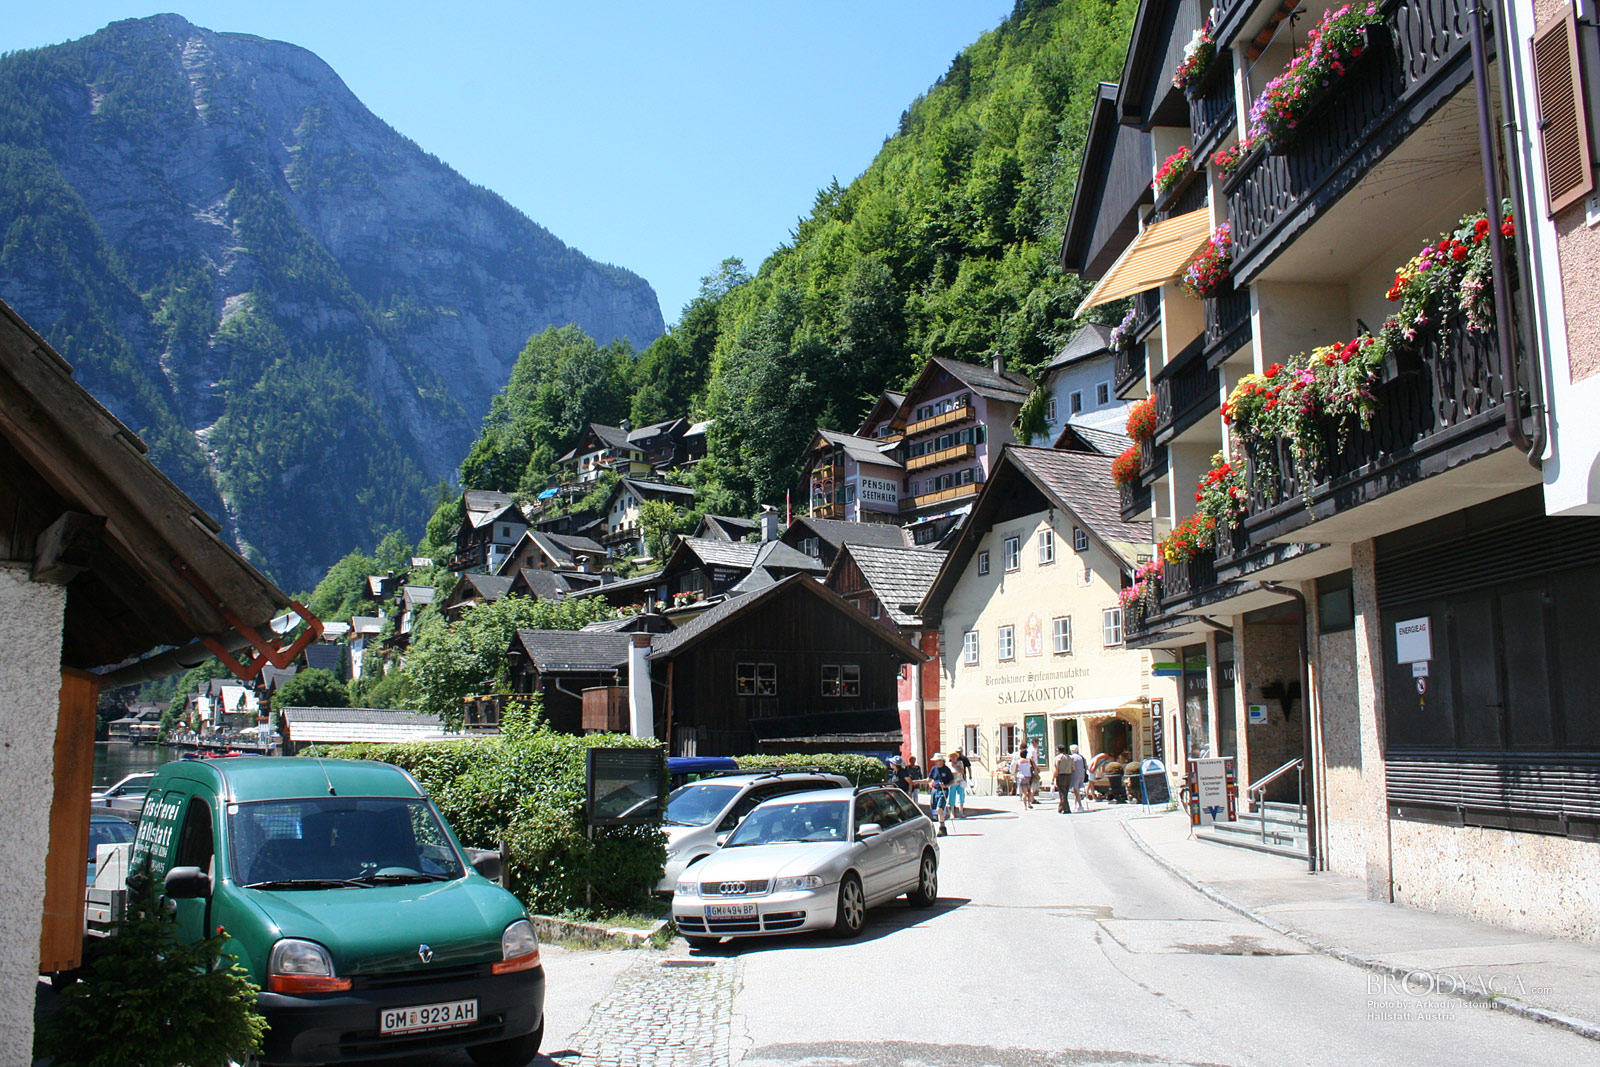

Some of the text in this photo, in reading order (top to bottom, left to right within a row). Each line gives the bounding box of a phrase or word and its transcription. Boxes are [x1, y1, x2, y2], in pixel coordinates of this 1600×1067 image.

[863, 479, 896, 491] PENSION
[863, 490, 896, 502] SEETHALER
[985, 667, 1090, 686] Benediktiner Seifenmanufaktur
[998, 685, 1075, 705] SALZKONTOR
[143, 797, 181, 820] Fischerei
[137, 820, 172, 846] Hallstatt
[711, 905, 753, 915] GM 494 BP
[385, 1011, 407, 1029] GM
[420, 1006, 450, 1025] 923
[454, 1002, 474, 1021] AH
